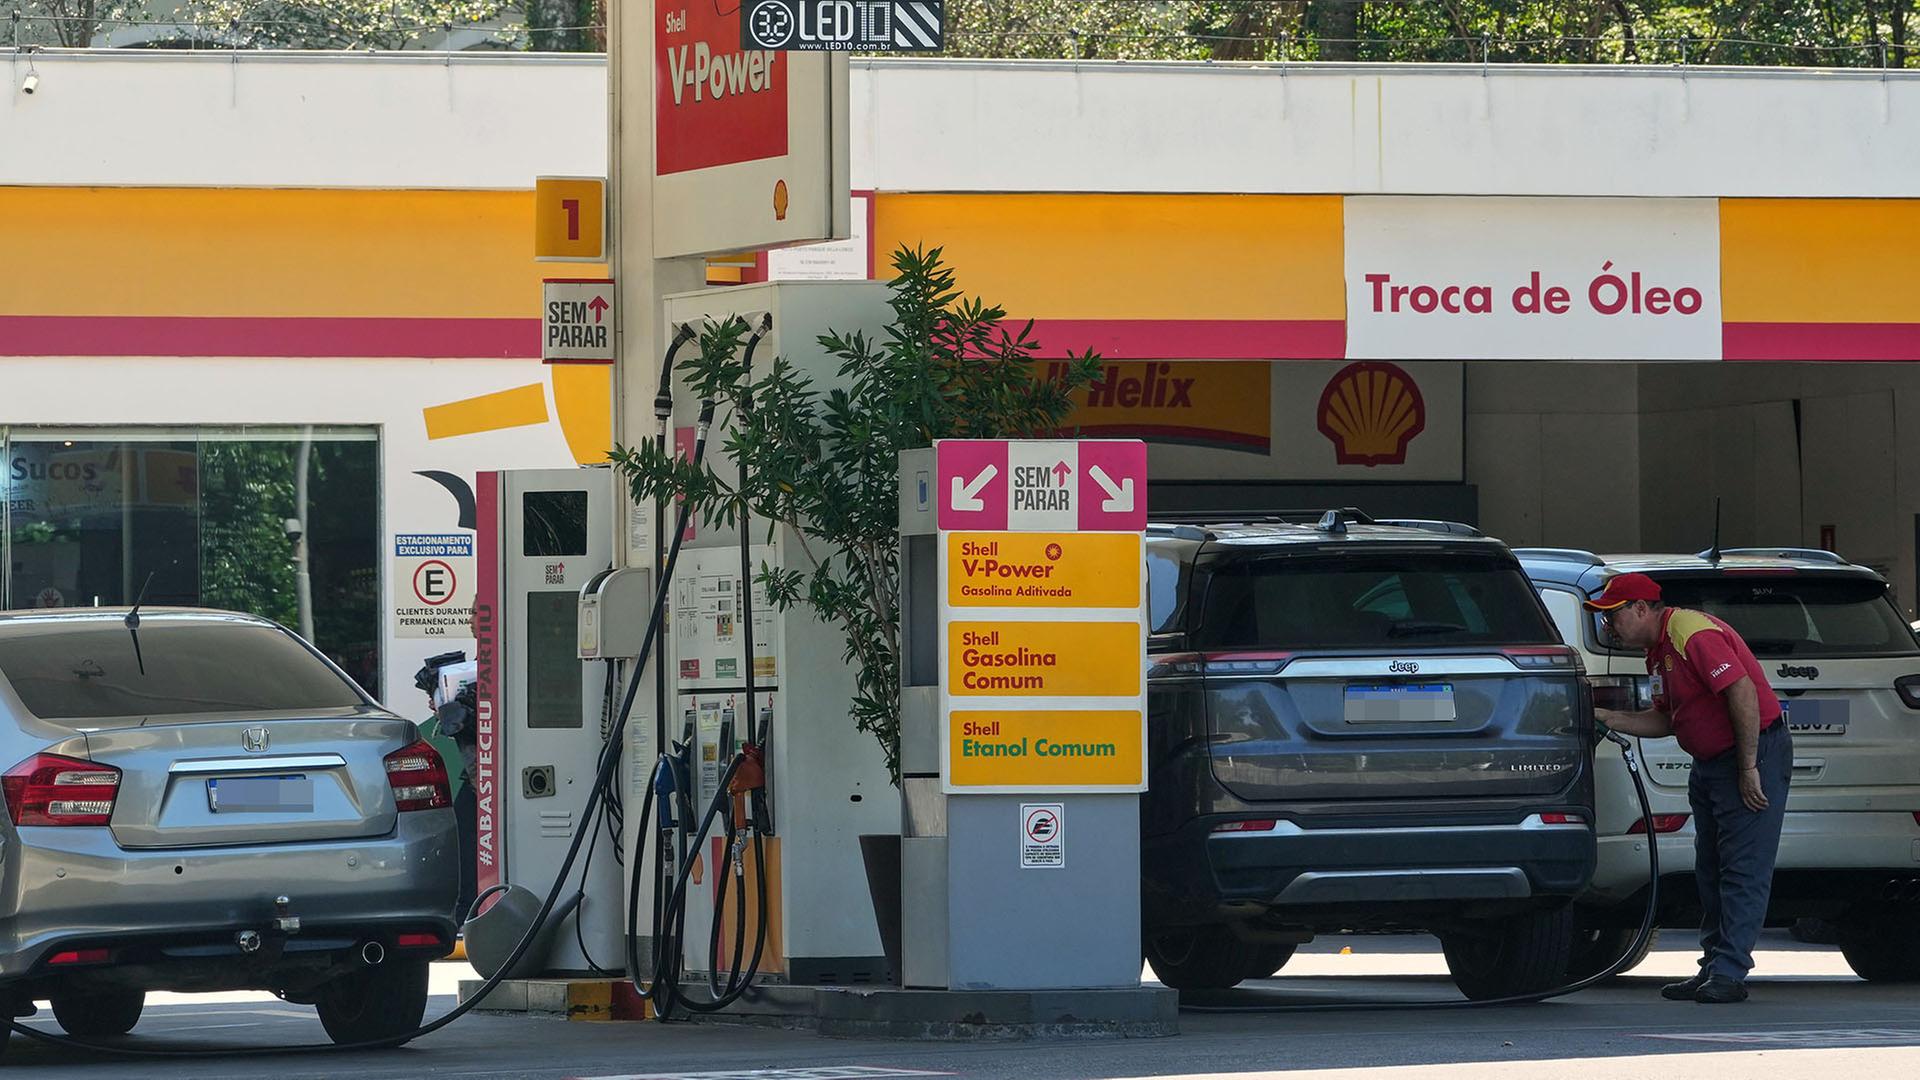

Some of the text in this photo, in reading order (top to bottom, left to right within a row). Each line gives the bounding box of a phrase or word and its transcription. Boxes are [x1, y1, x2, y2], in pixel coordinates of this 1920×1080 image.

[666, 10, 686, 33] Shell
[800, 0, 890, 41] LED10
[799, 42, 891, 51] www.LED10.com.br
[668, 41, 775, 105] V-Power
[562, 200, 579, 240] 1
[1365, 260, 1703, 315] Troca de Óleo
[549, 302, 586, 323] SEM
[549, 325, 606, 348] PARAR
[1088, 362, 1195, 408] Helix
[11, 457, 97, 480] Sucos
[1014, 466, 1050, 488] SEM
[1014, 490, 1070, 511] PARAR
[396, 536, 471, 545] ESTACIONAMENTO
[962, 542, 998, 556] Shell
[400, 546, 468, 555] EXCLUSIVO PARA
[962, 559, 1054, 578] V-Power
[426, 570, 444, 596] E
[961, 585, 1072, 597] Gasolina Aditivada
[396, 608, 434, 616] CLIENTES
[425, 627, 445, 635] LOJA
[962, 631, 999, 646] Shell
[962, 647, 1057, 668] Gasolina
[1389, 661, 1419, 673] Jeep
[962, 671, 1043, 689] Comum
[1777, 664, 1819, 680] Jeep
[963, 722, 1000, 736] Shell
[963, 738, 1116, 757] Etanol Comum
